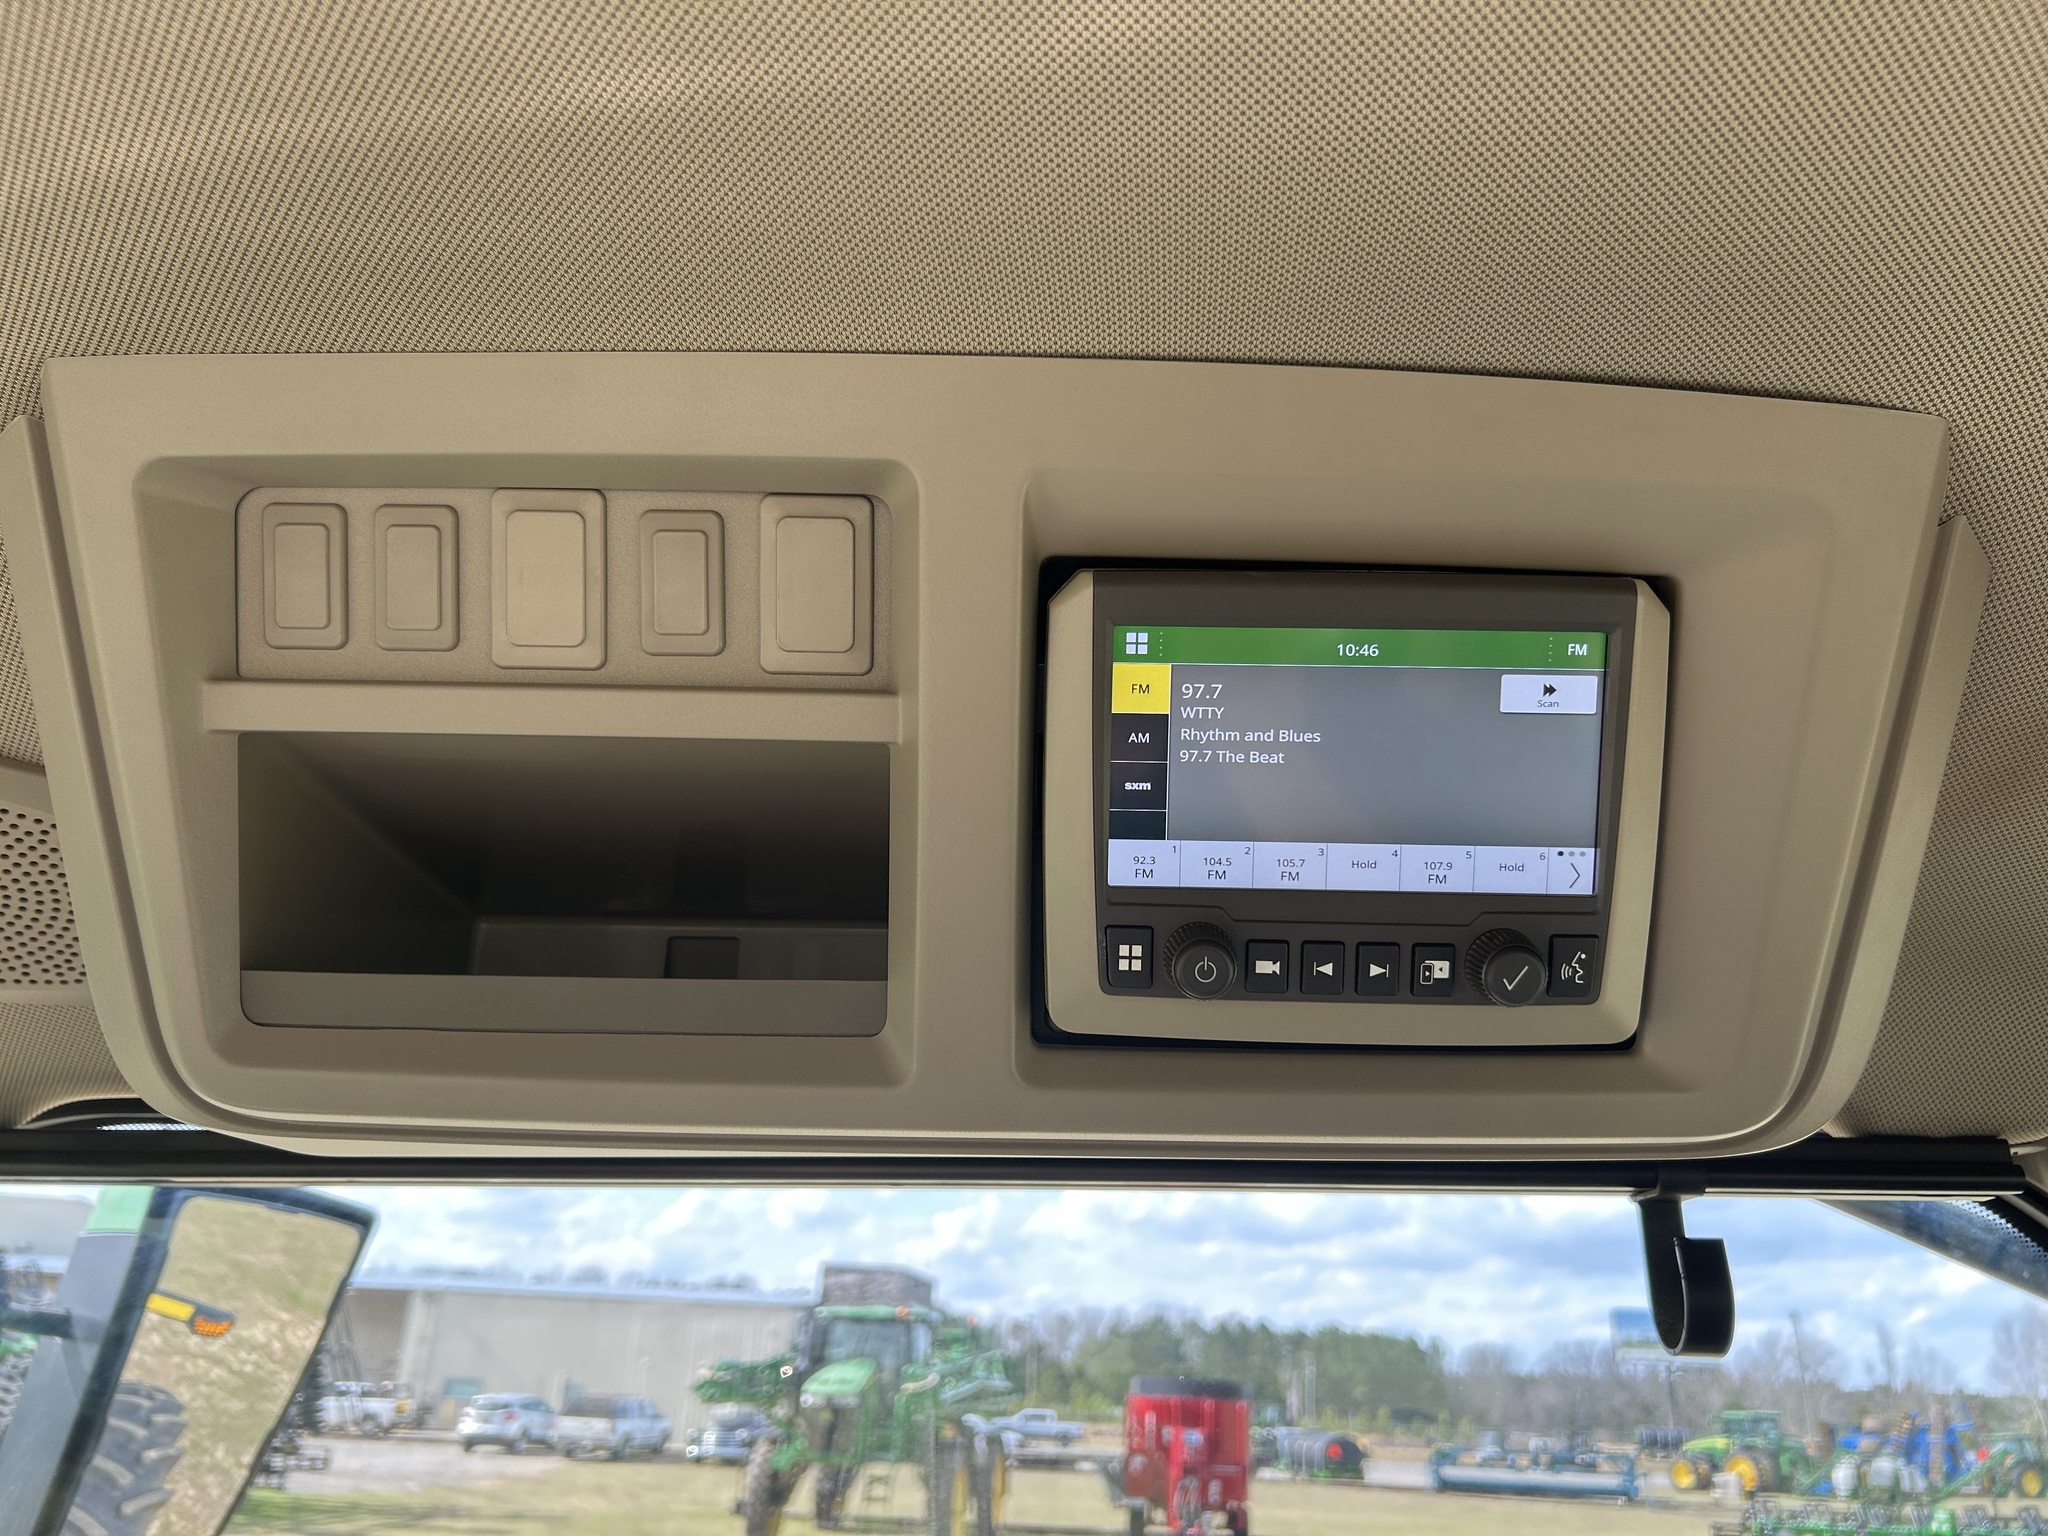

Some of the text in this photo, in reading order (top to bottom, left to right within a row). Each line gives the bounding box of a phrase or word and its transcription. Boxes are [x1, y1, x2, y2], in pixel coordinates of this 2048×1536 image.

[1336, 643, 1379, 657] 10:46
[1567, 643, 1588, 656] FM
[1131, 683, 1150, 695] FM
[1181, 683, 1223, 699] 97.7
[1537, 700, 1560, 708] Scan
[1180, 706, 1225, 719] WTTY
[1128, 732, 1150, 744] AM
[1180, 727, 1321, 744] Rhythm and Blues
[1179, 749, 1285, 764] 97.7 The Beat
[1124, 782, 1152, 791] sxm
[1172, 845, 1177, 854] 1
[1244, 846, 1251, 855] 2
[1317, 847, 1324, 857] 3
[1391, 849, 1398, 858] 4
[1133, 855, 1156, 865] 92.3
[1465, 850, 1472, 860] 5
[1539, 852, 1546, 861] 6
[1203, 857, 1232, 867] 104.5
[1276, 858, 1306, 868] 105.7
[1351, 860, 1377, 869] Hold
[1423, 861, 1453, 871] 107.9
[1499, 863, 1525, 872] Hold
[1134, 868, 1154, 879] FM
[1207, 869, 1227, 880] FM
[1280, 871, 1300, 882] FM
[1427, 874, 1447, 885] FM
